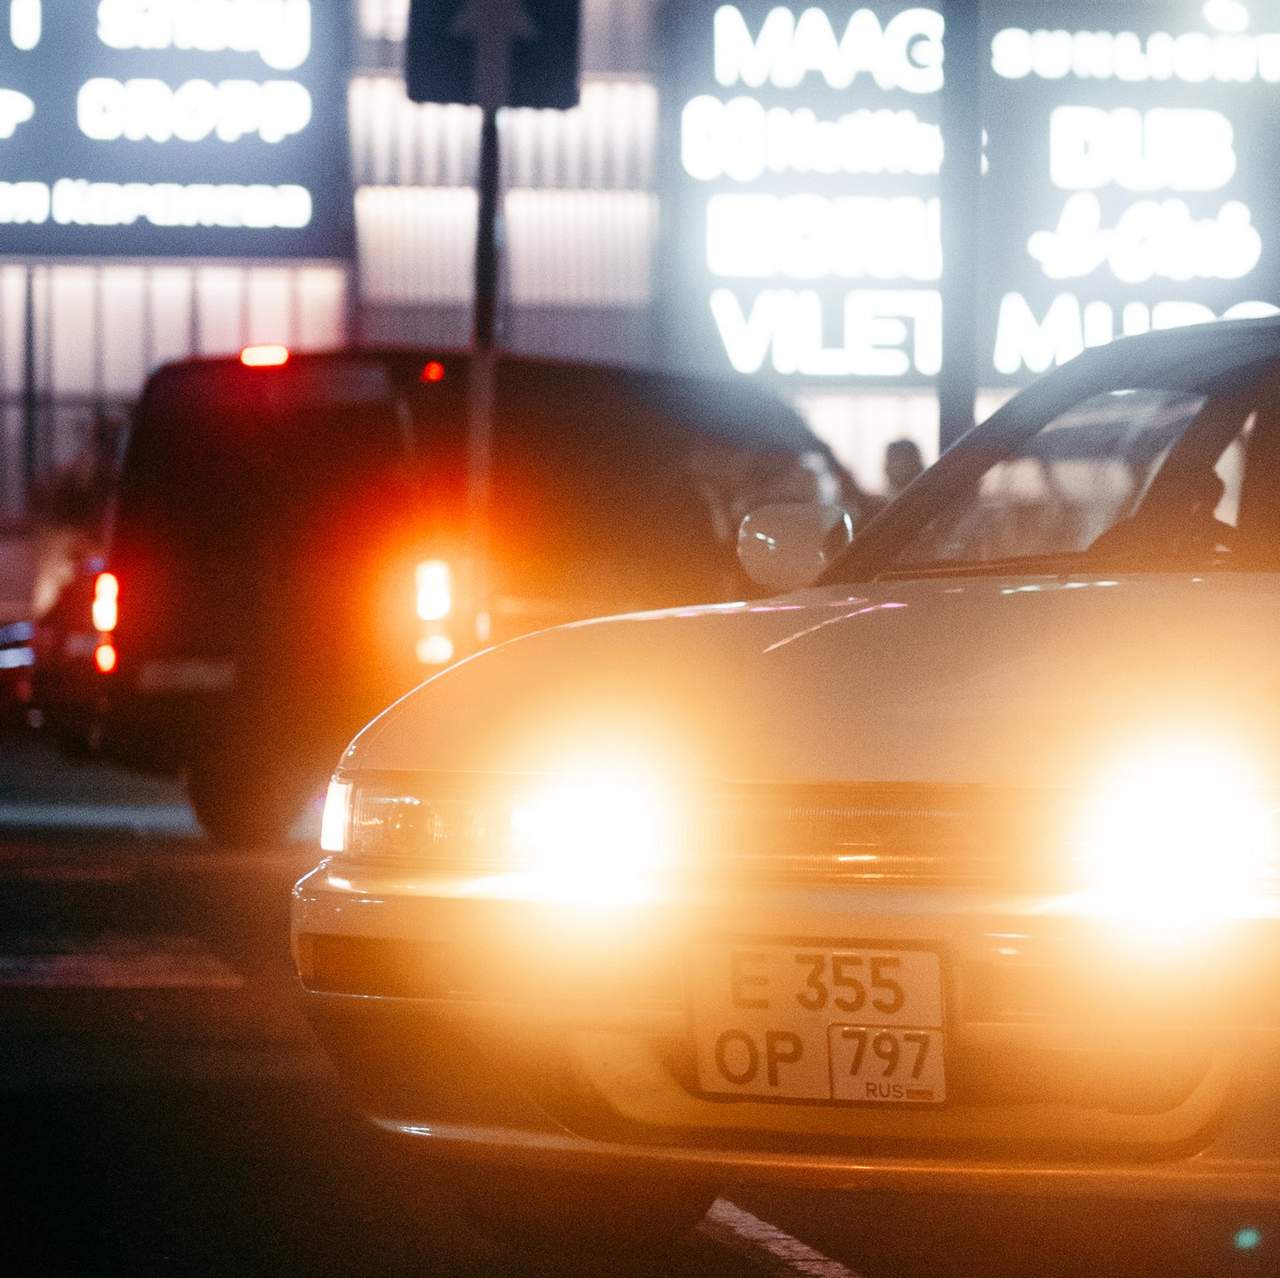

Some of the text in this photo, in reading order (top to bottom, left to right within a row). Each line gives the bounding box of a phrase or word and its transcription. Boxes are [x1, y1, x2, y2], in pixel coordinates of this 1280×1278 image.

[714, 5, 944, 94] MAAG
[731, 952, 906, 1015] E 355
[714, 1028, 804, 1088] OP
[841, 1028, 932, 1079] 797
[865, 1082, 905, 1099] RUS
